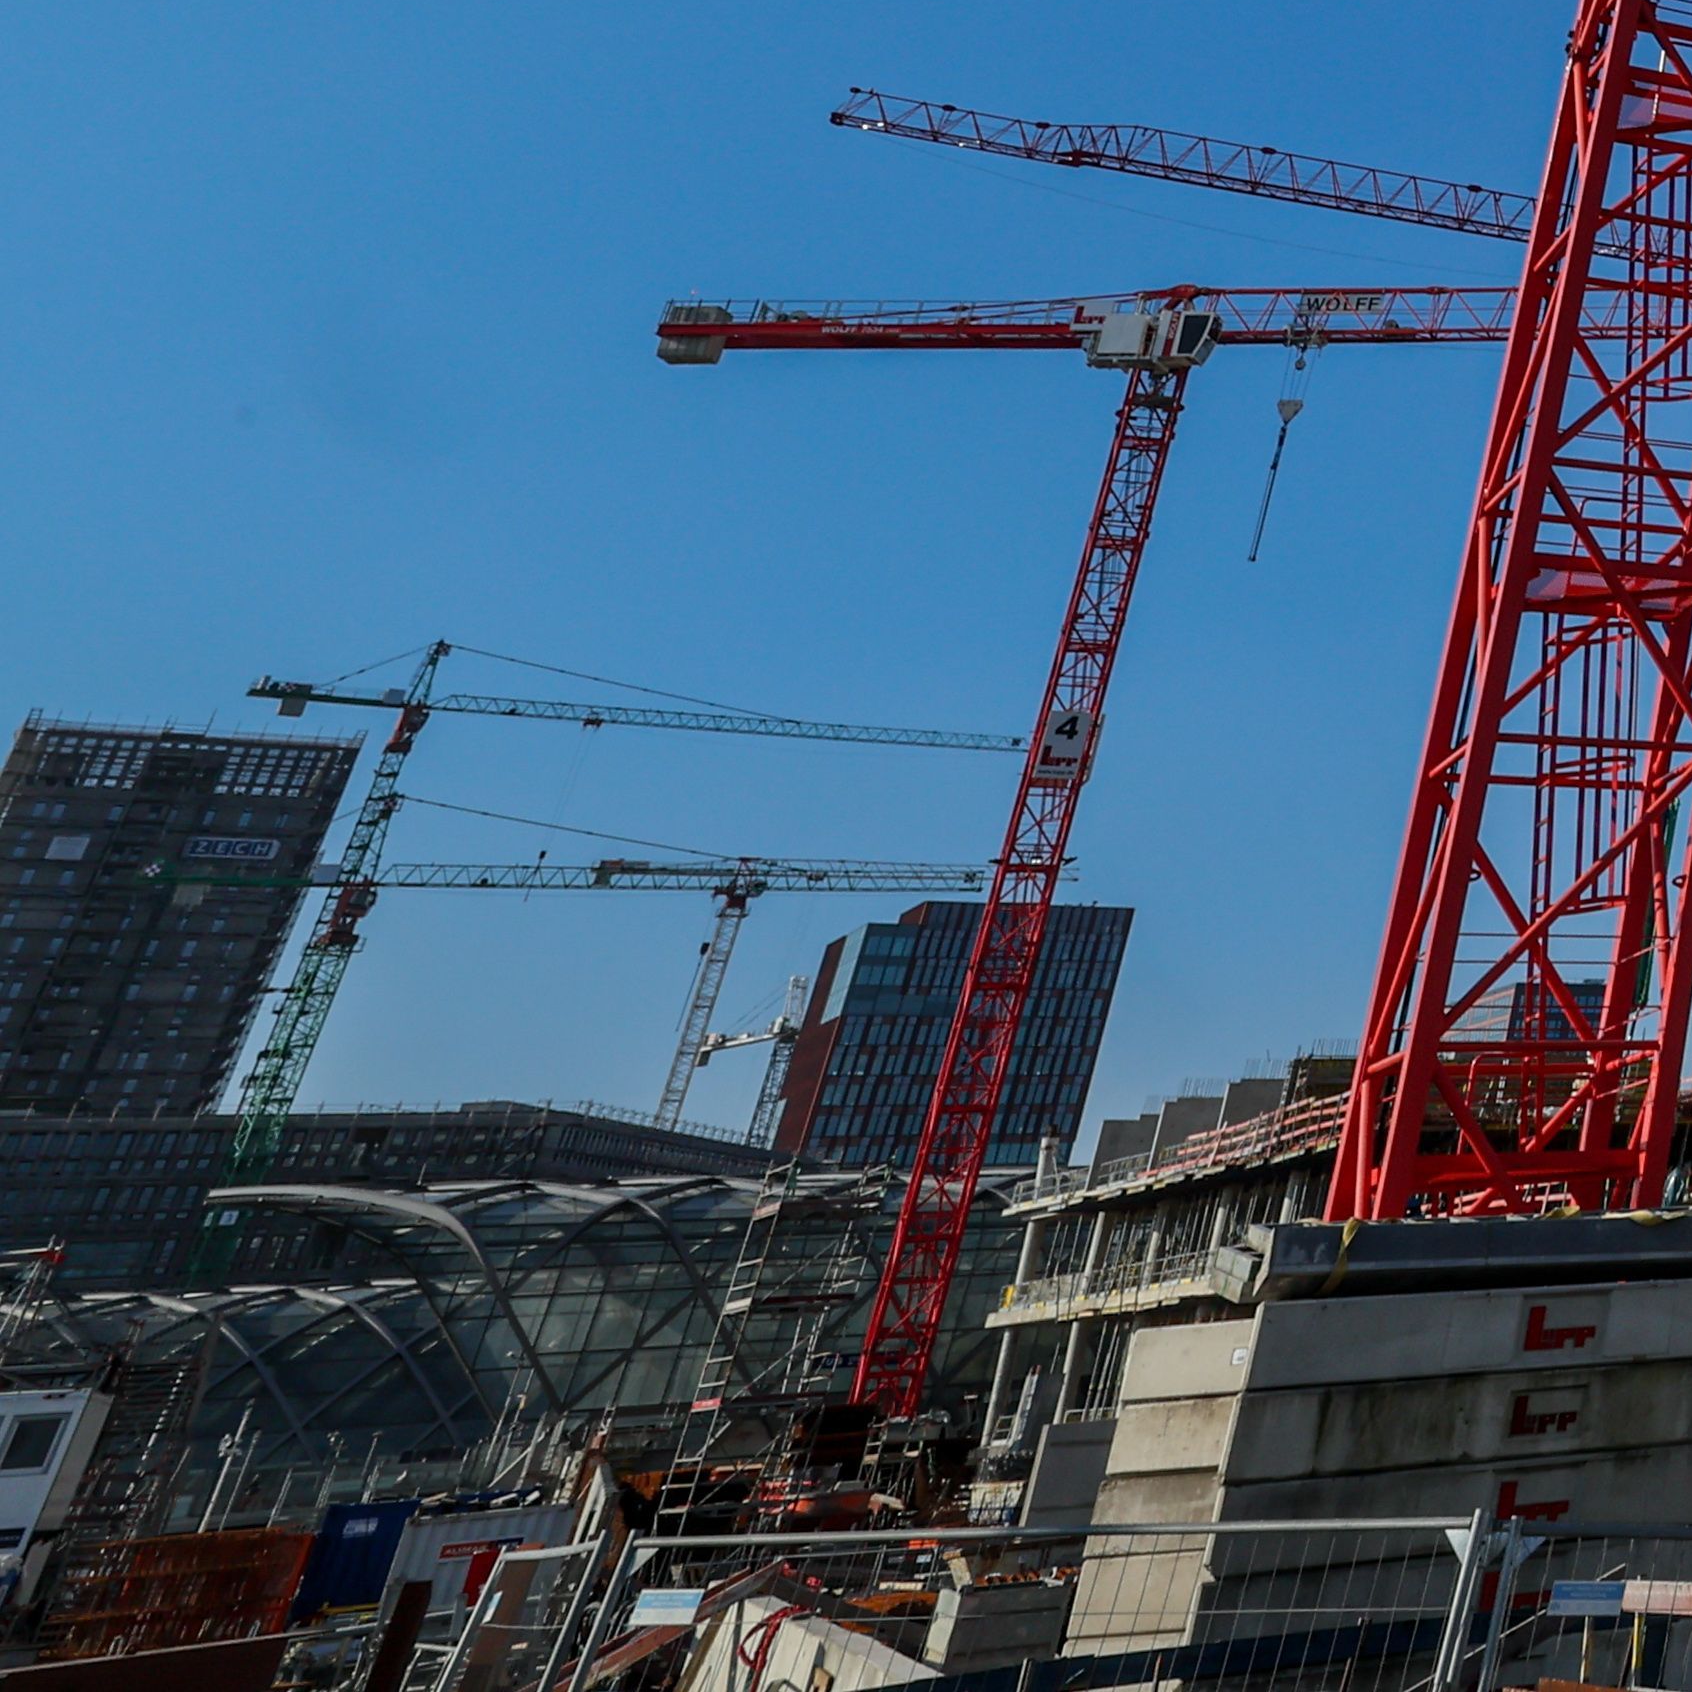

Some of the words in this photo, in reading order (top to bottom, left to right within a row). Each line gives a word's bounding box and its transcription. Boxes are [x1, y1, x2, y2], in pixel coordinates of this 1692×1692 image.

[1307, 297, 1381, 311] WOLFF
[1055, 716, 1079, 740] 4
[195, 841, 269, 854] ZECH
